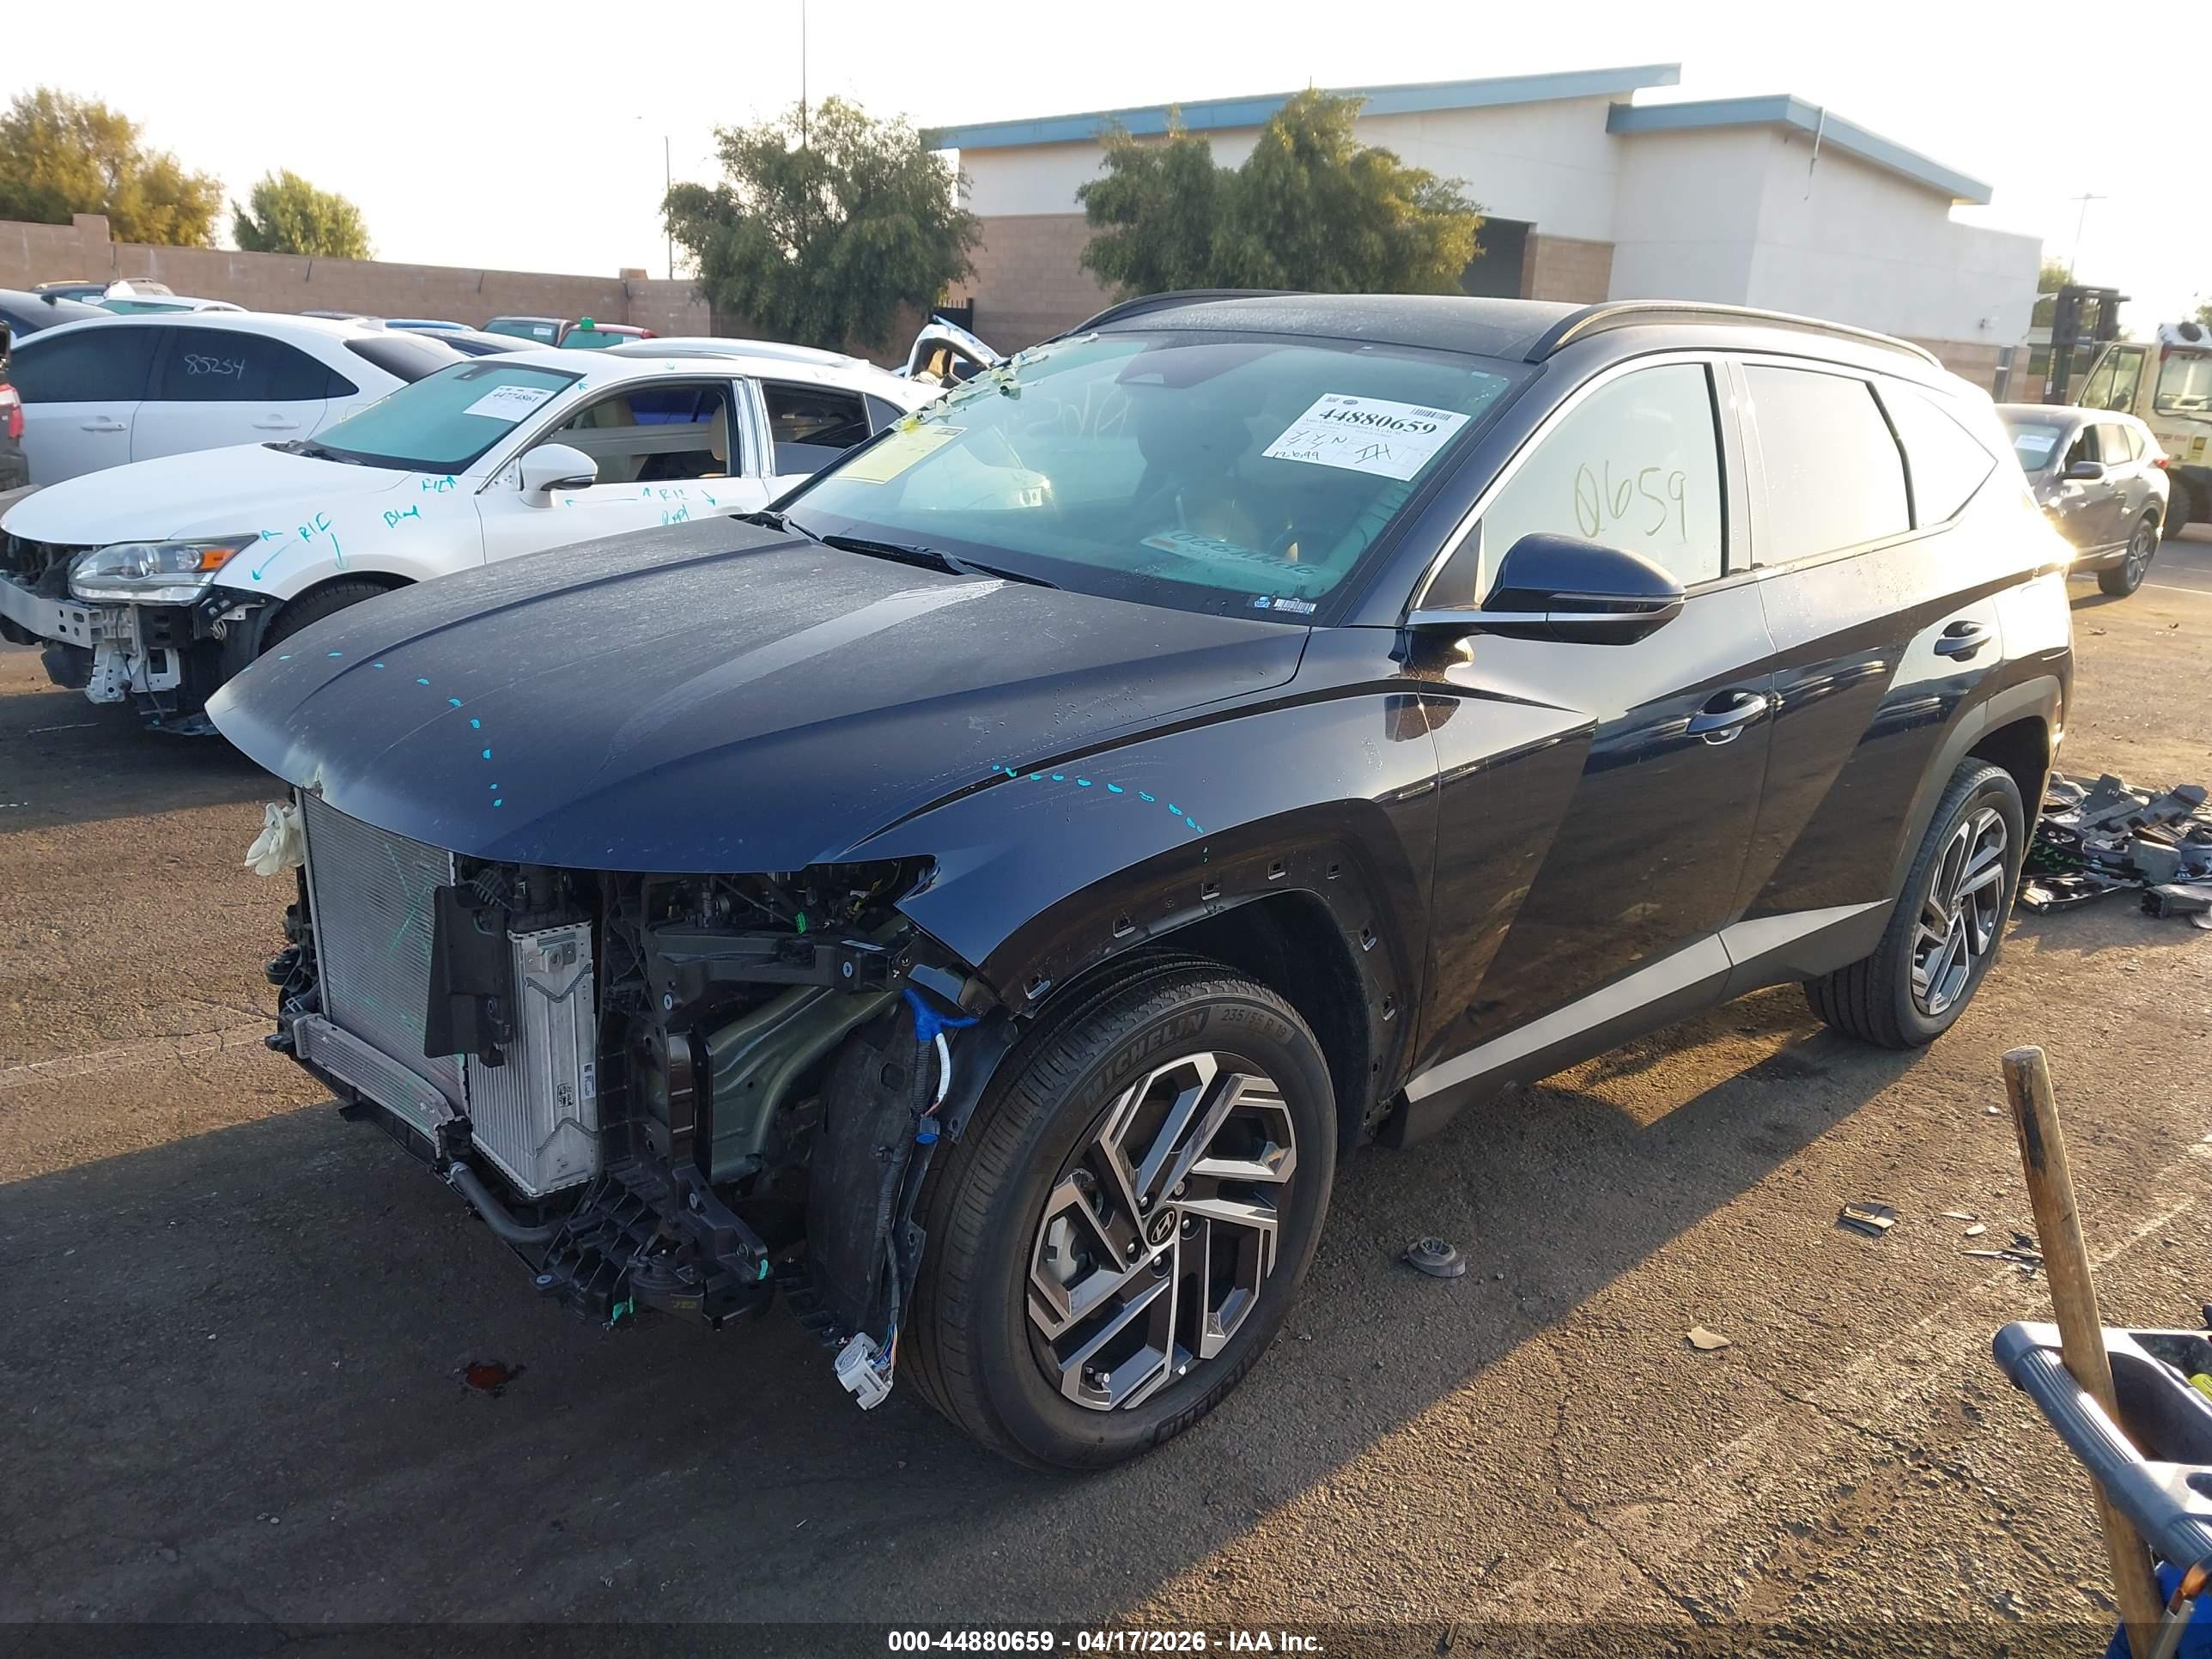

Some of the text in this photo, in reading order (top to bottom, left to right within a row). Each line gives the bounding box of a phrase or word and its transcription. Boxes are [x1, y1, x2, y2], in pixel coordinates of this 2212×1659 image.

[185, 354, 246, 380] 85254
[1319, 408, 1437, 434] 44880659
[1221, 1008, 1265, 1025] 235/55
[1083, 1012, 1204, 1108] MICHELIN
